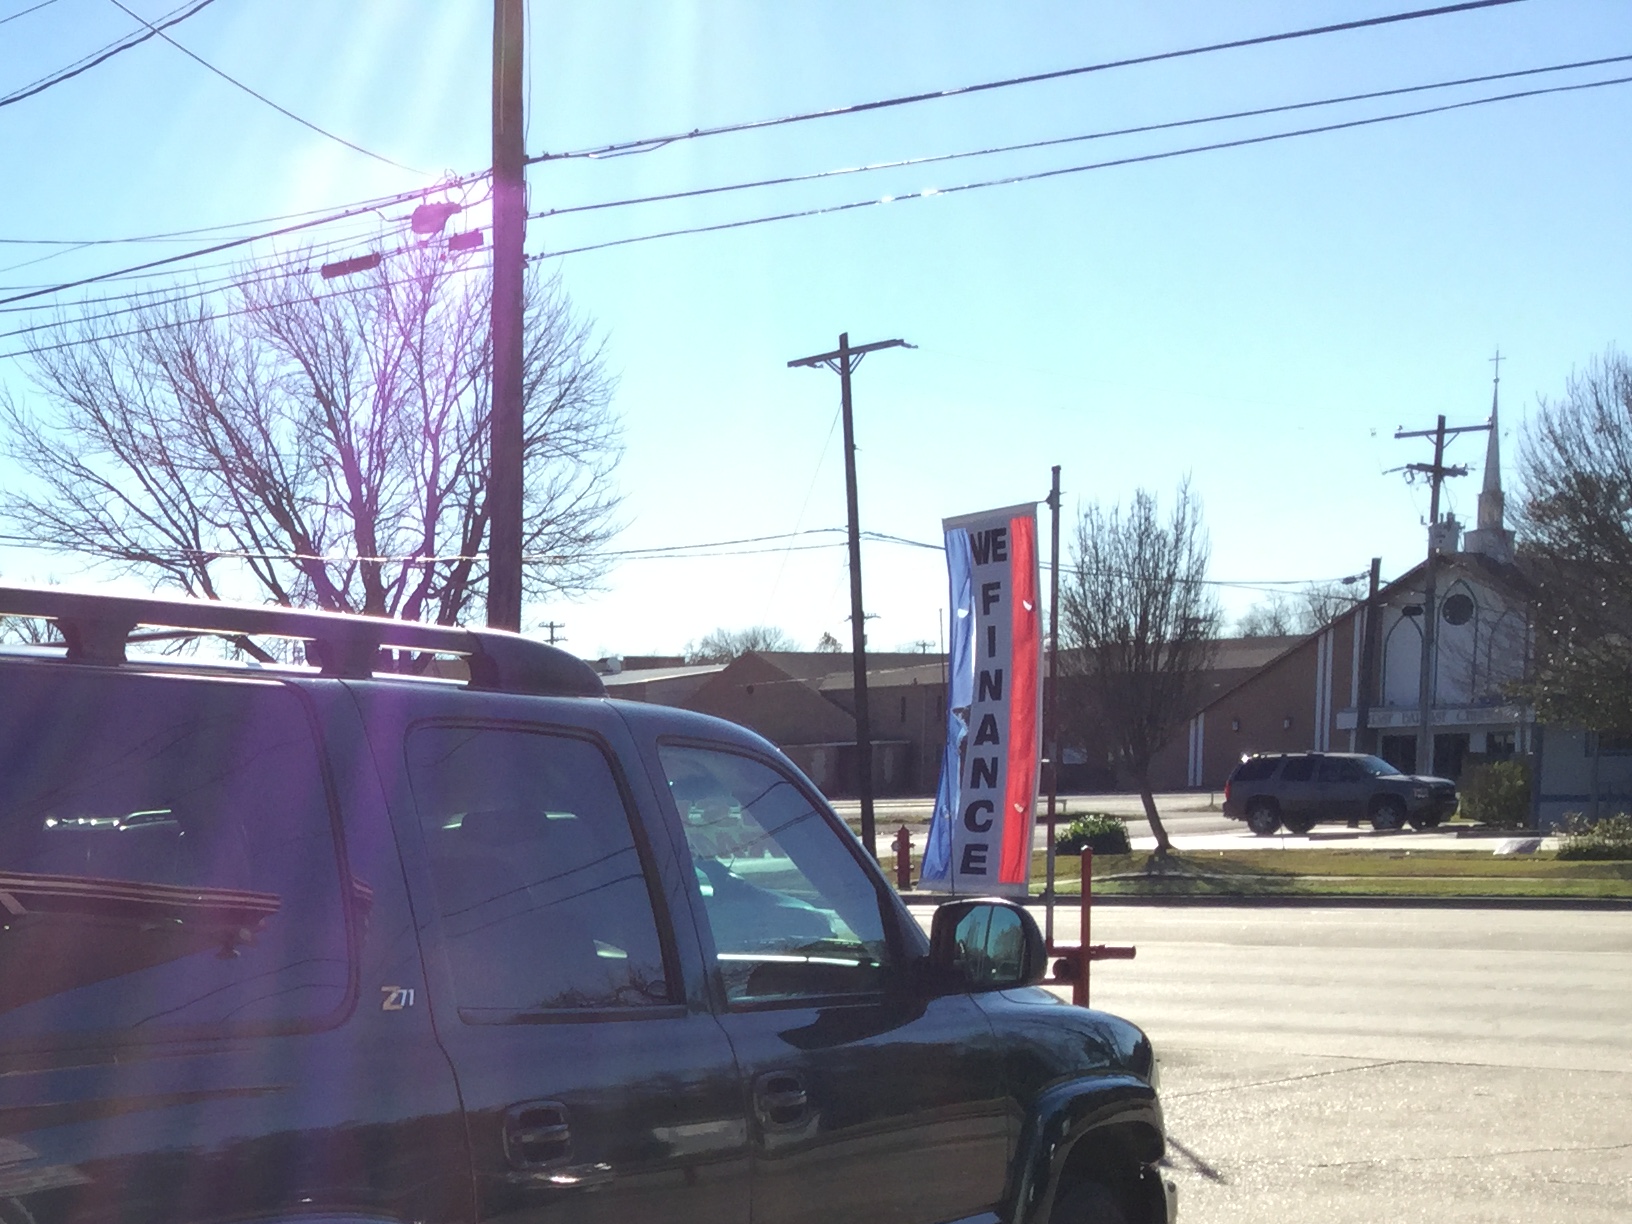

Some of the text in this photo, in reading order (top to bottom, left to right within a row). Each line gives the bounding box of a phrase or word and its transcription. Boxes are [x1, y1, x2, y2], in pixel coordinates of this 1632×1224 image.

[970, 527, 1007, 565] WE
[960, 582, 1003, 876] FINANCE
[381, 985, 415, 1011] Z71
